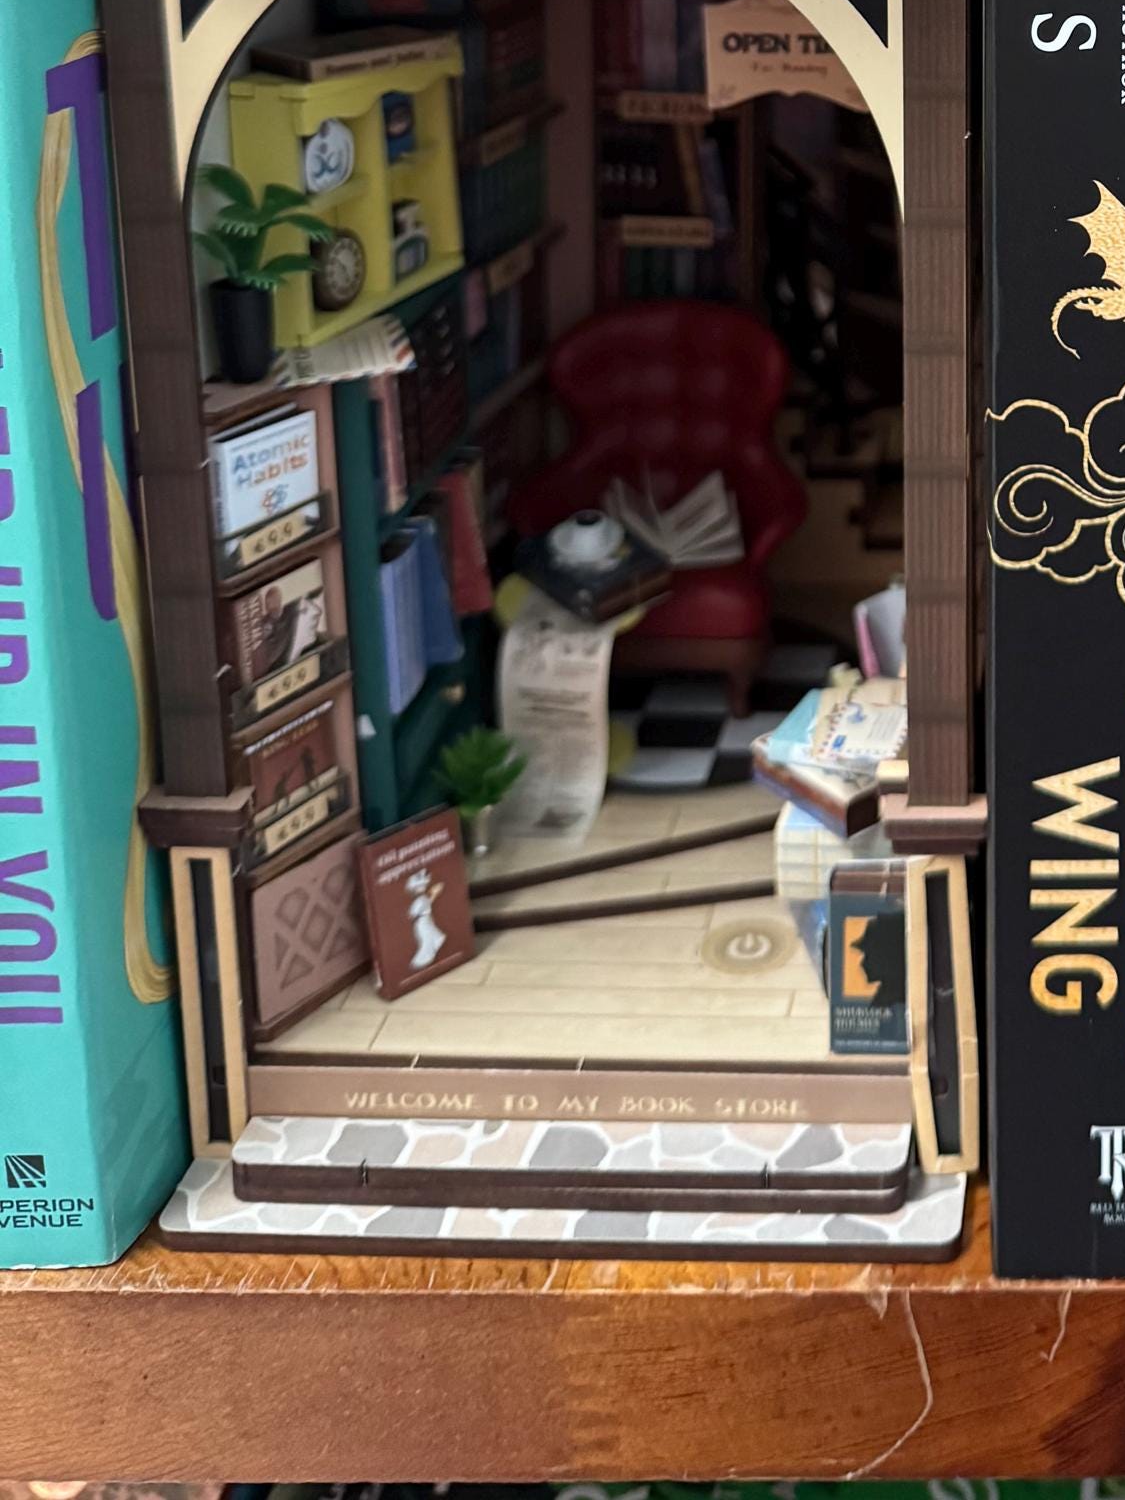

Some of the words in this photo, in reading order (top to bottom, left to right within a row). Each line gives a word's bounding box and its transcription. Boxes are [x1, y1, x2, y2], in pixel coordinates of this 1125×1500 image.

[722, 32, 791, 54] OPEN
[233, 434, 311, 474] Atomic
[237, 452, 310, 487] Habits
[1028, 756, 1121, 1017] WING
[344, 1092, 481, 1111] WELCOME
[503, 1094, 540, 1112] TO
[557, 1094, 600, 1113] MY
[618, 1095, 697, 1114] BOOK
[713, 1097, 808, 1117] STORE
